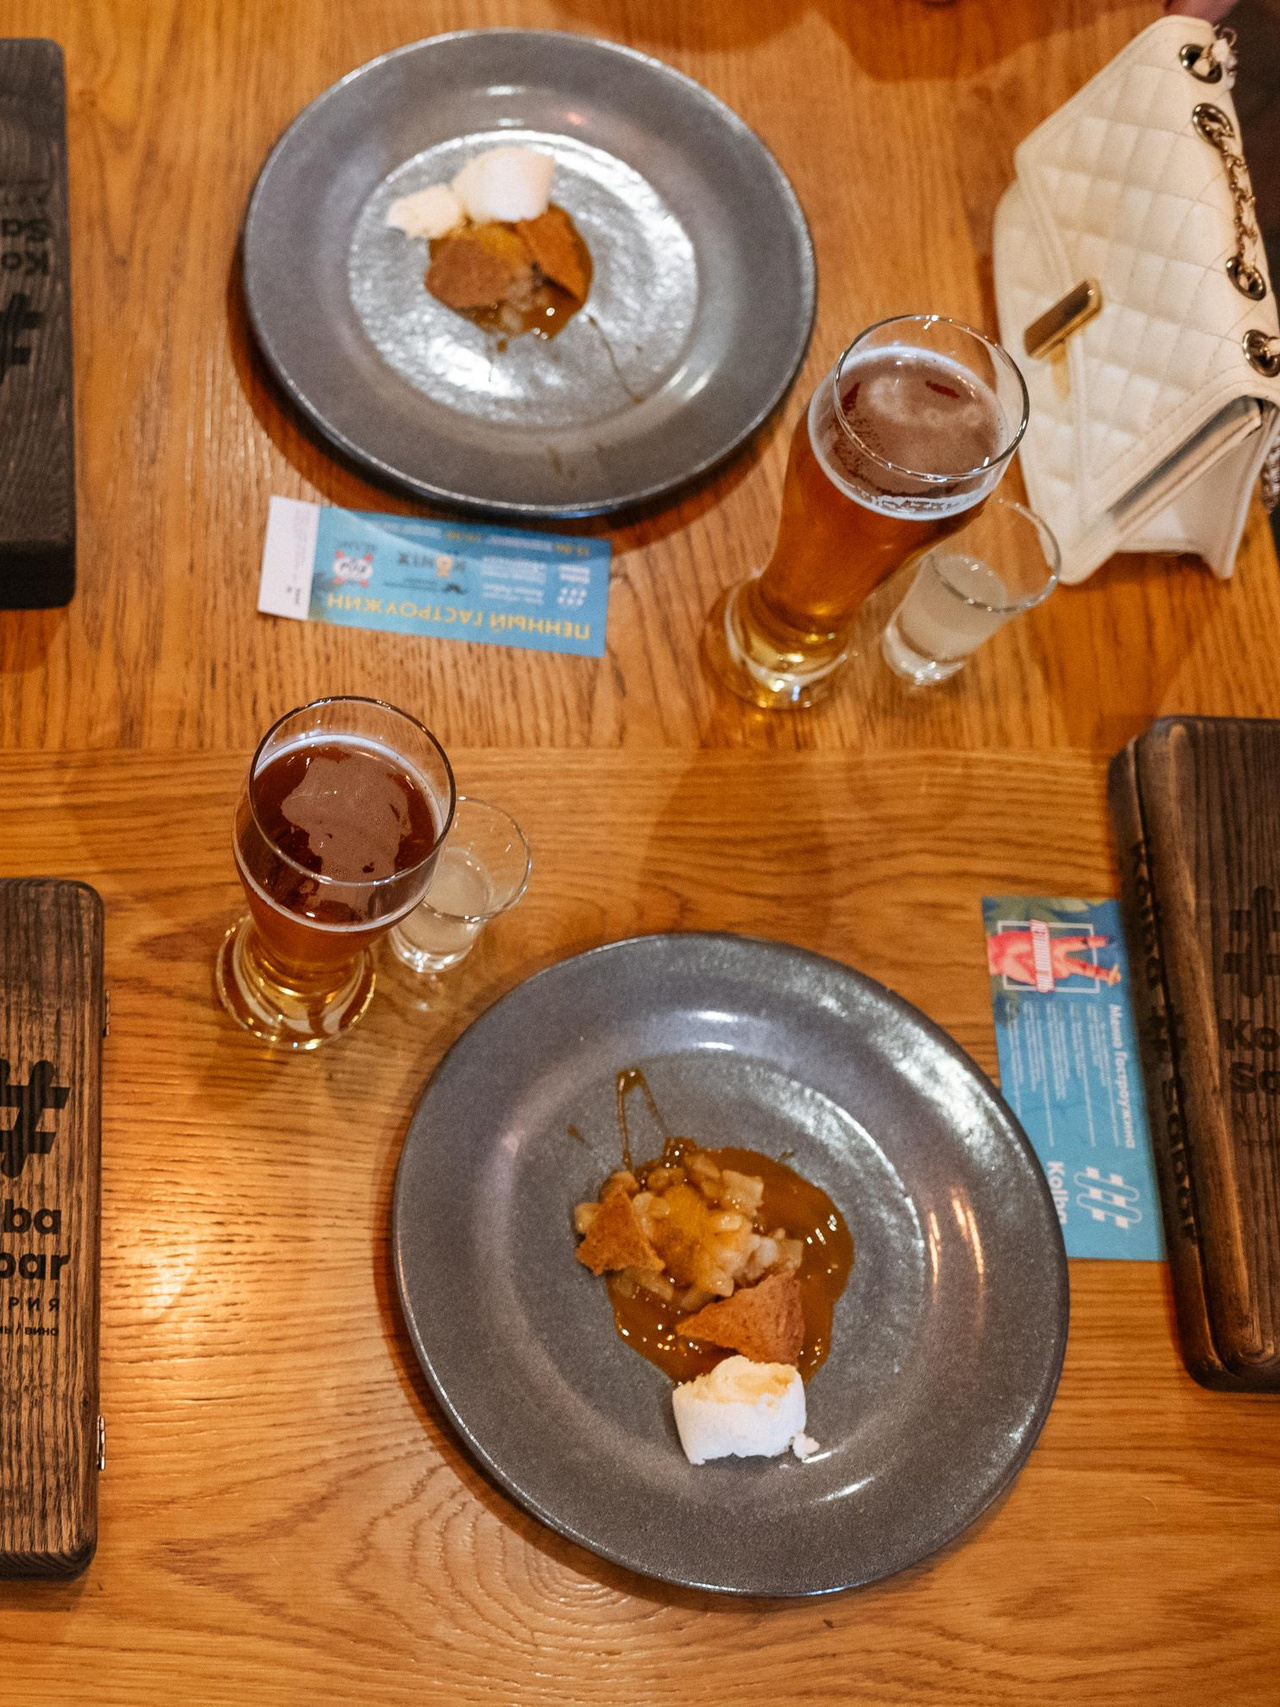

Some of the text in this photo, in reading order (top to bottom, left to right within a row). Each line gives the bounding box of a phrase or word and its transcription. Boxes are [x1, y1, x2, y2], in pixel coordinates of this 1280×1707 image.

[327, 592, 483, 627] ГАСТРОУЖИН
[490, 613, 590, 640] ПЕННЫЙ
[24, 1326, 59, 1337] вино
